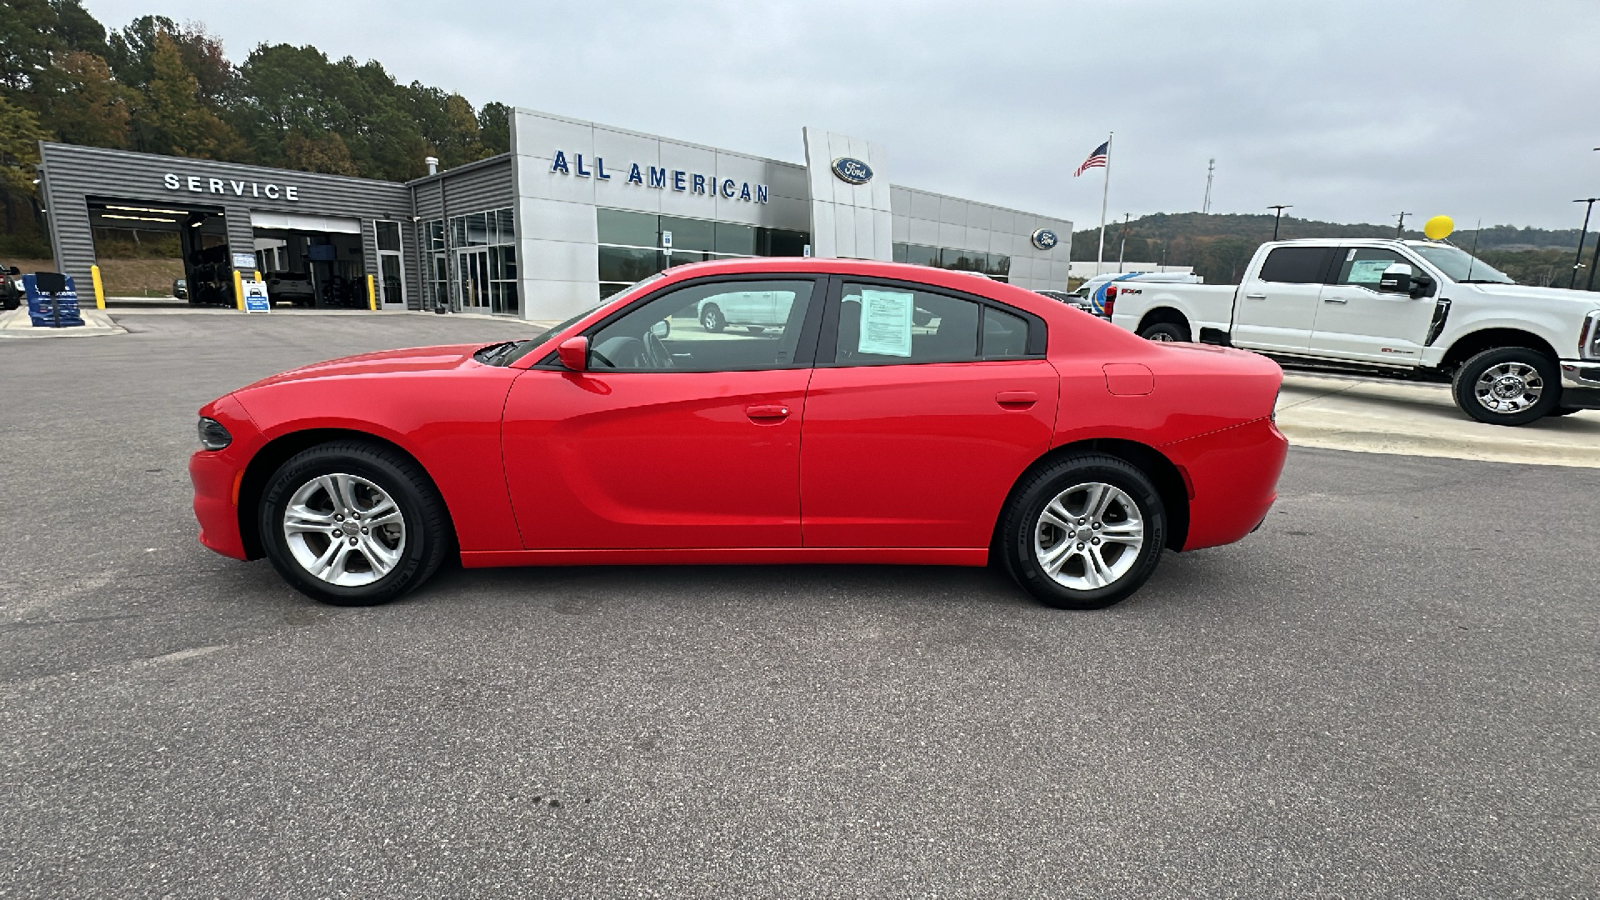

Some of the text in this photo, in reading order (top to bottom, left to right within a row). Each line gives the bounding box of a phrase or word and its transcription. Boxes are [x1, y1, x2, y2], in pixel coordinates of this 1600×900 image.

[551, 150, 769, 204] ALL AMERICAN
[844, 161, 866, 179] Ford
[164, 173, 299, 201] SERVICE
